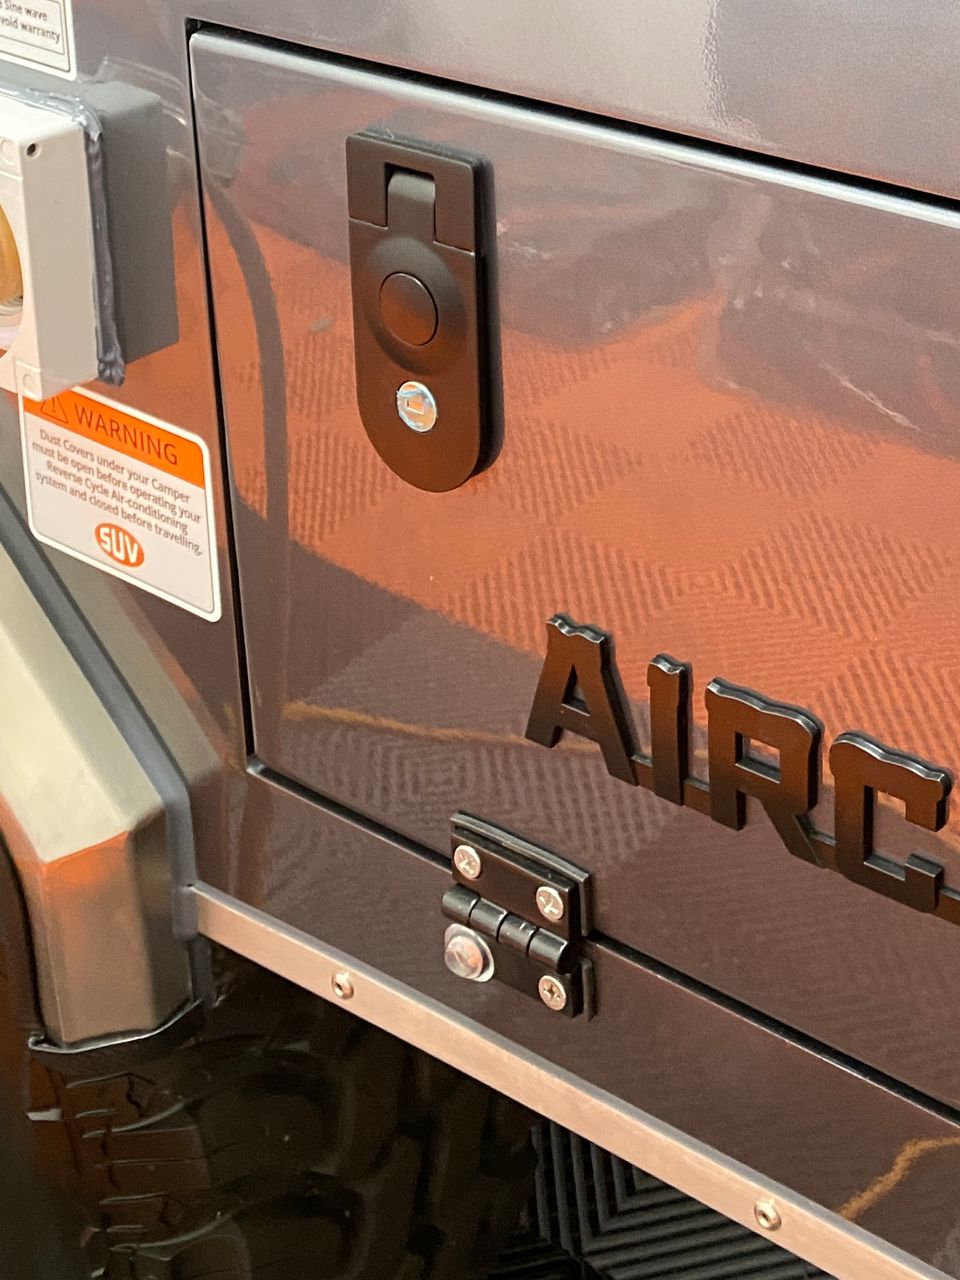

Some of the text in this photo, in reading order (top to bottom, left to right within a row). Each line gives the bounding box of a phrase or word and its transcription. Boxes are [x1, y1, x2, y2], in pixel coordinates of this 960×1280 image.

[4, 0, 23, 14] Sine
[25, 6, 48, 21] wave
[20, 22, 60, 44] warranty
[75, 403, 178, 466] WARNING
[32, 441, 201, 524] must be open before operating your
[40, 428, 191, 503] Dust Covers under your Camper
[36, 471, 68, 493] system
[69, 487, 87, 502] and
[89, 495, 119, 517] closed
[121, 507, 152, 531] before
[47, 459, 189, 536] Reverse Cycle Air-conditioning
[99, 527, 139, 564] SUV
